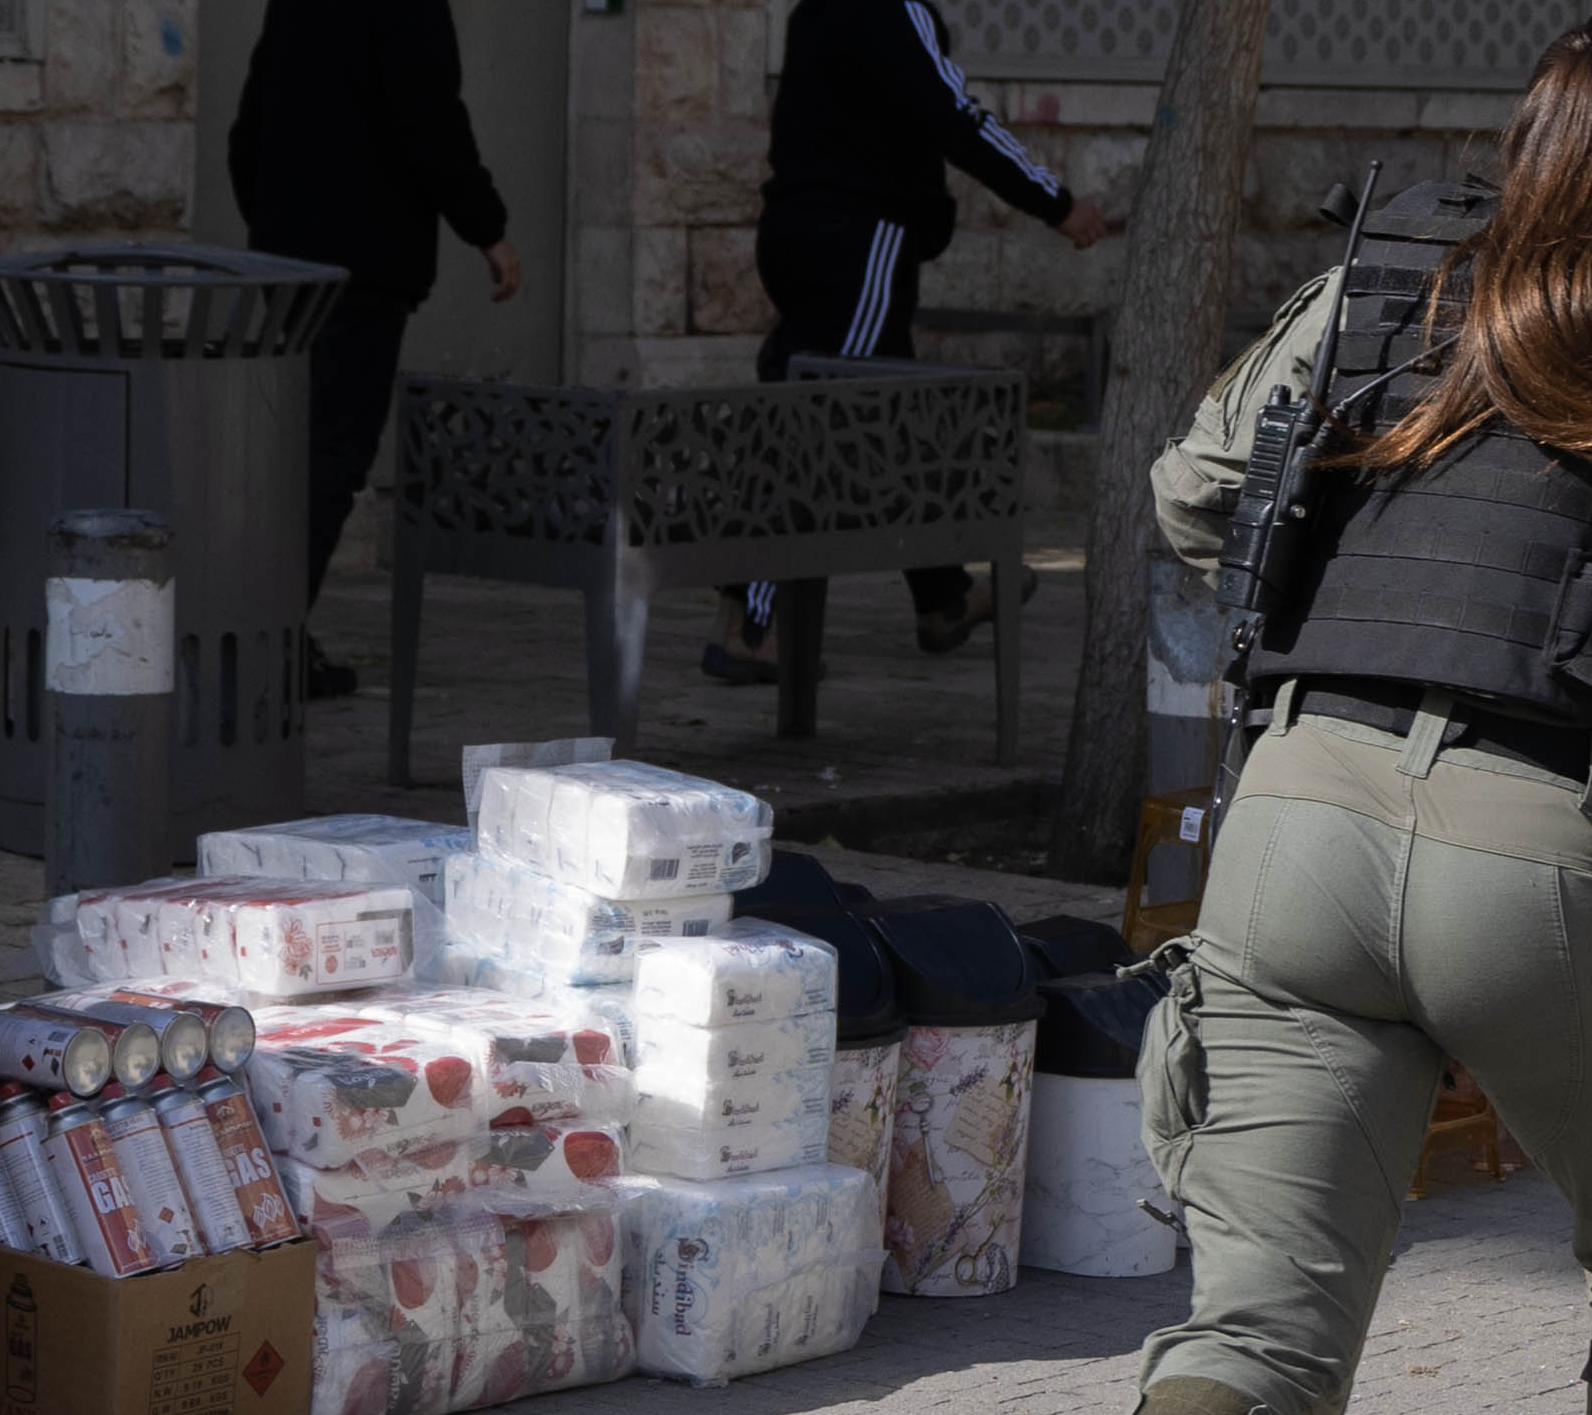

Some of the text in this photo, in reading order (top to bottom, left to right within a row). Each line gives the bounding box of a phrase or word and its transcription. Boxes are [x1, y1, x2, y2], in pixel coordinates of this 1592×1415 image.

[90, 1176, 134, 1215] GA
[673, 1236, 711, 1336] Sindibad
[167, 1315, 233, 1343] JAMPOW
